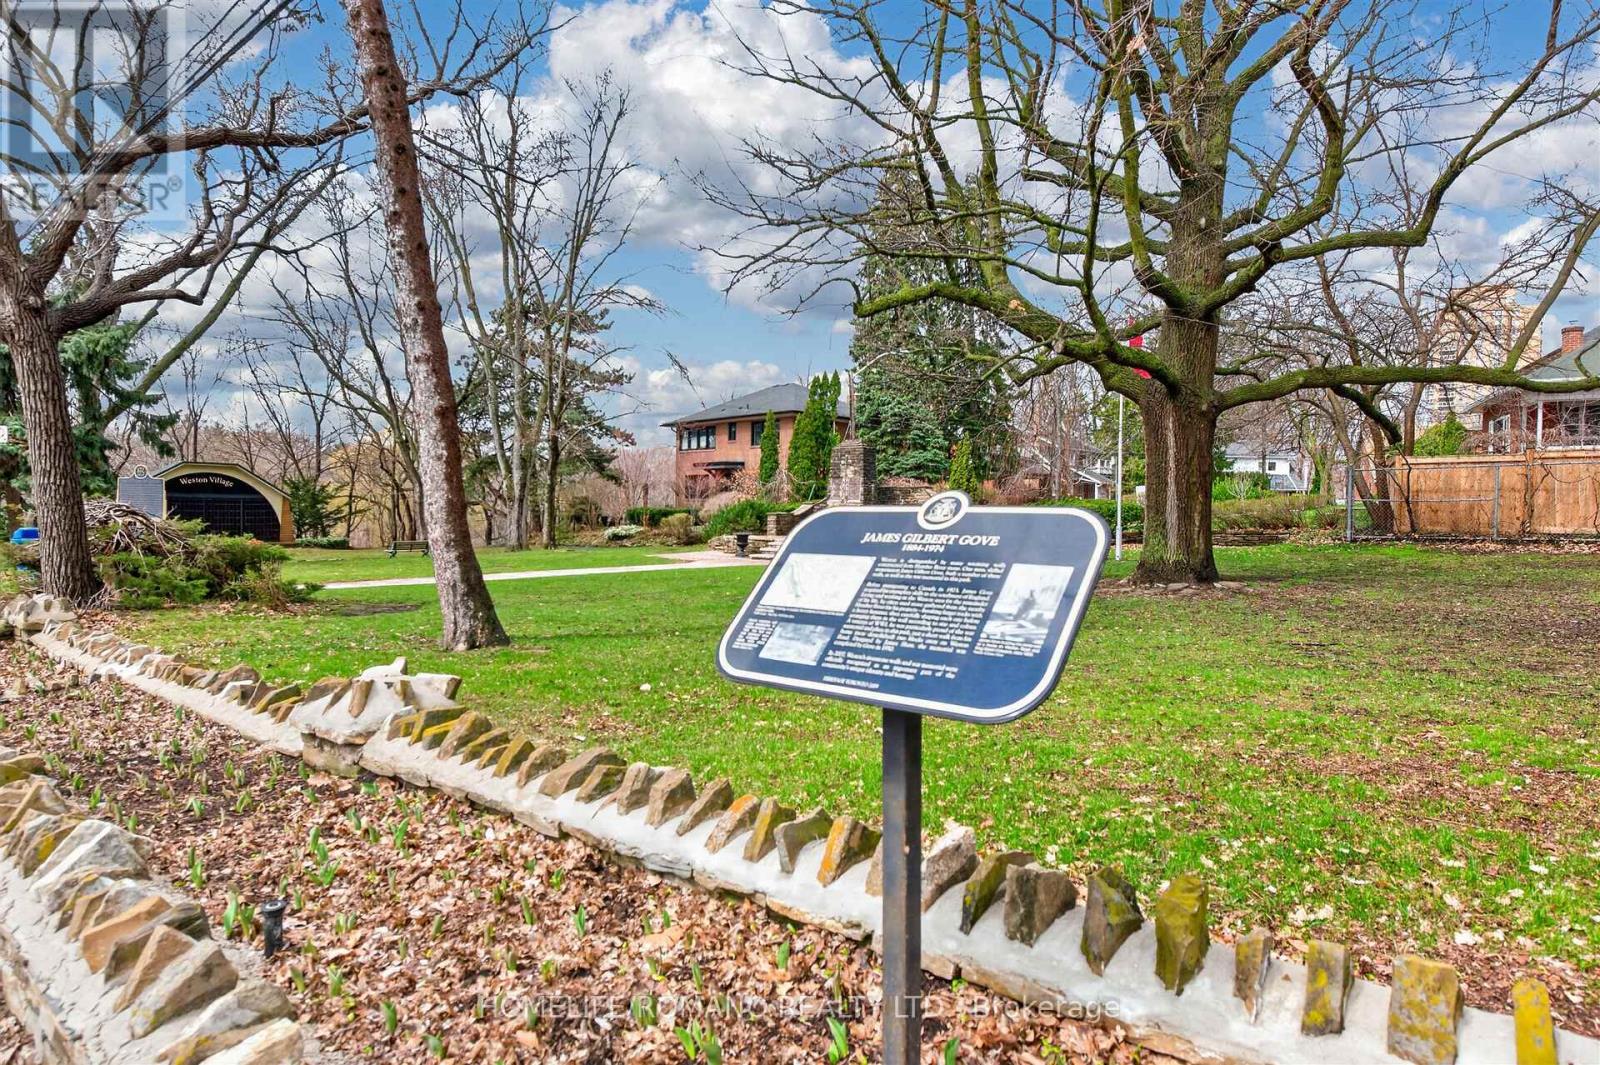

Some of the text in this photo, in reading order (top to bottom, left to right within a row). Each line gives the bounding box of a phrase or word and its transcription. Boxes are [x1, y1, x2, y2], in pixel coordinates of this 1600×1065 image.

[179, 475, 234, 487] Weston Village
[860, 532, 1000, 546] JAMES GILBERT GOVE
